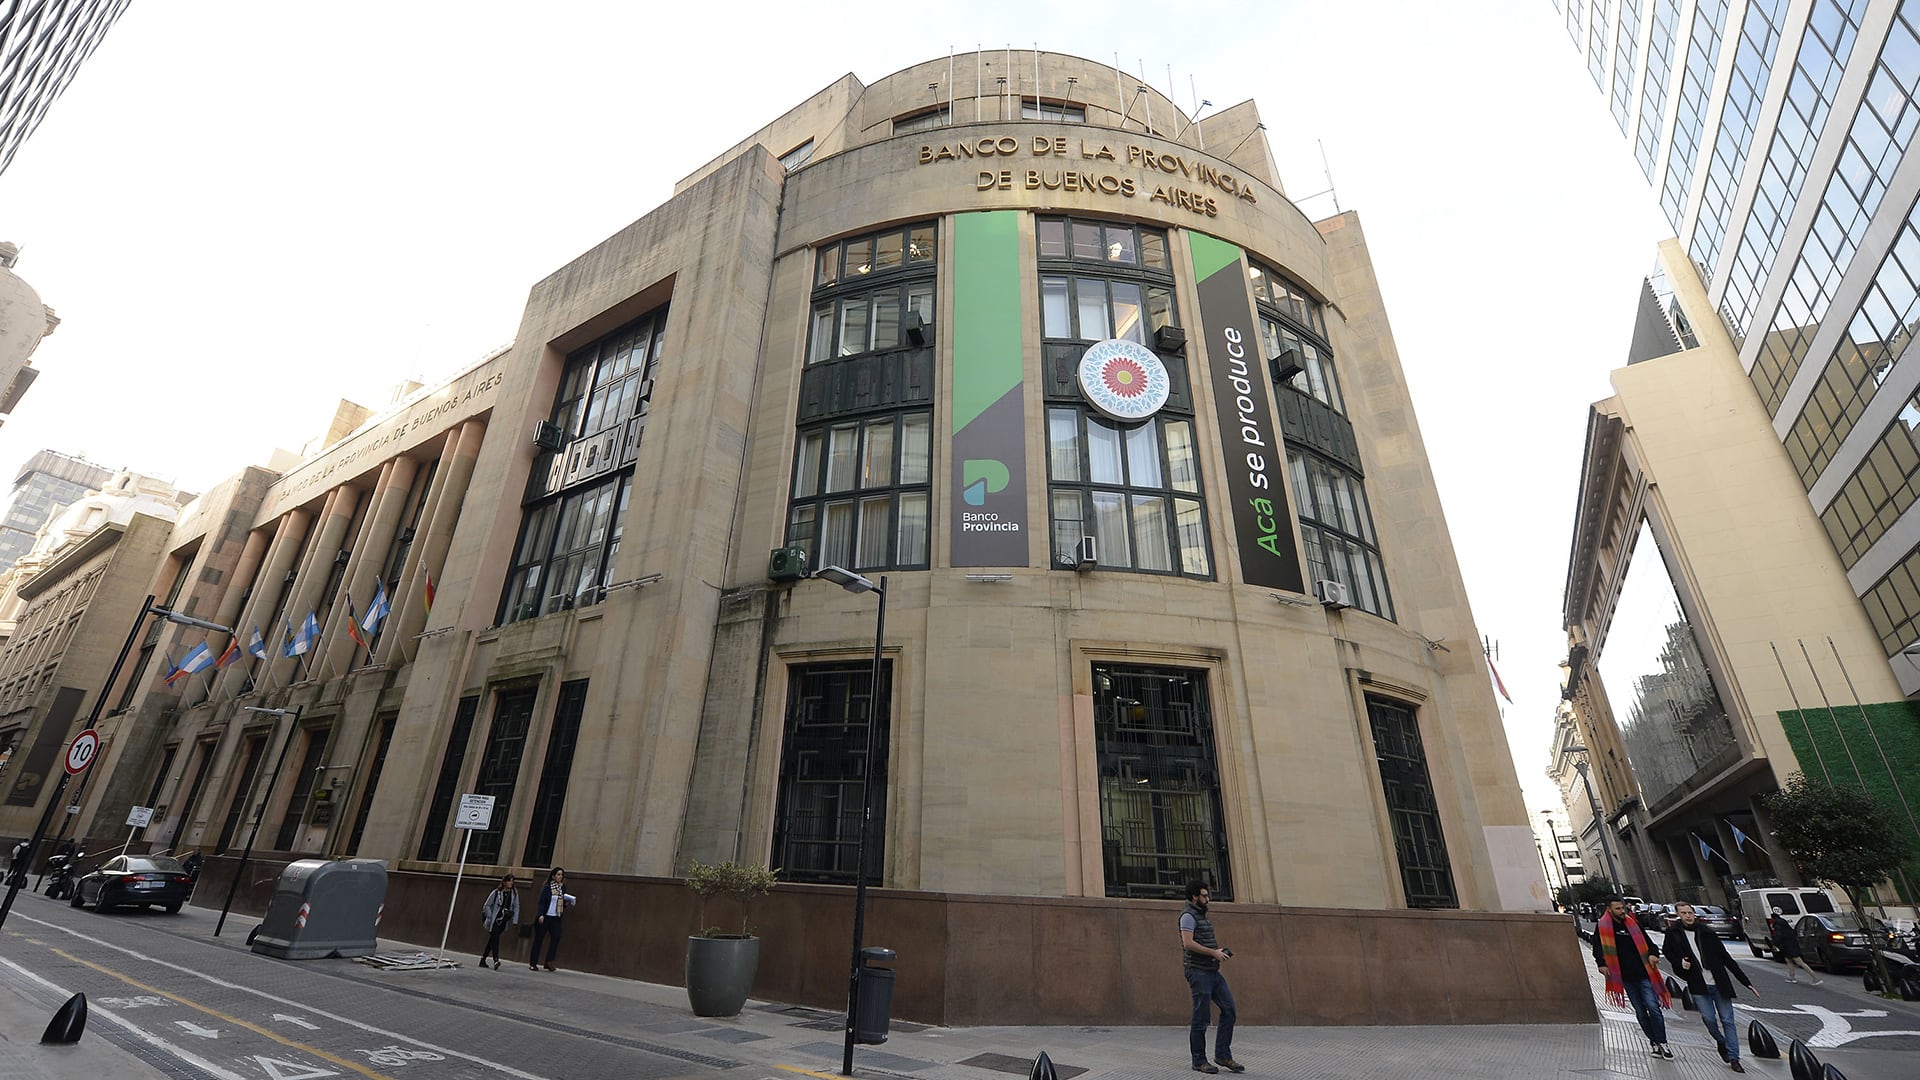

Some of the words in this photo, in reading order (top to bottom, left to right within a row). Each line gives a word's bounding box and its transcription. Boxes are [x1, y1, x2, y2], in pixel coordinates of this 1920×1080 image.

[919, 136, 1019, 164] BANCO
[1032, 135, 1067, 156] DE
[1080, 138, 1116, 162] LA
[1127, 144, 1257, 204] PROVINCIA
[977, 170, 1012, 191] DE
[1025, 169, 1136, 198] BUENOS
[1150, 184, 1218, 218] AIRES
[1224, 326, 1265, 446] produce
[337, 435, 389, 471] PROVINCIA
[393, 423, 409, 440] DE
[411, 396, 458, 431] BUENOS
[462, 372, 503, 404] AIRES
[1246, 452, 1268, 490] se
[963, 512, 999, 521] Banco
[963, 521, 1019, 531] Provincia
[1249, 497, 1281, 558] Acá
[73, 742, 92, 762] 10
